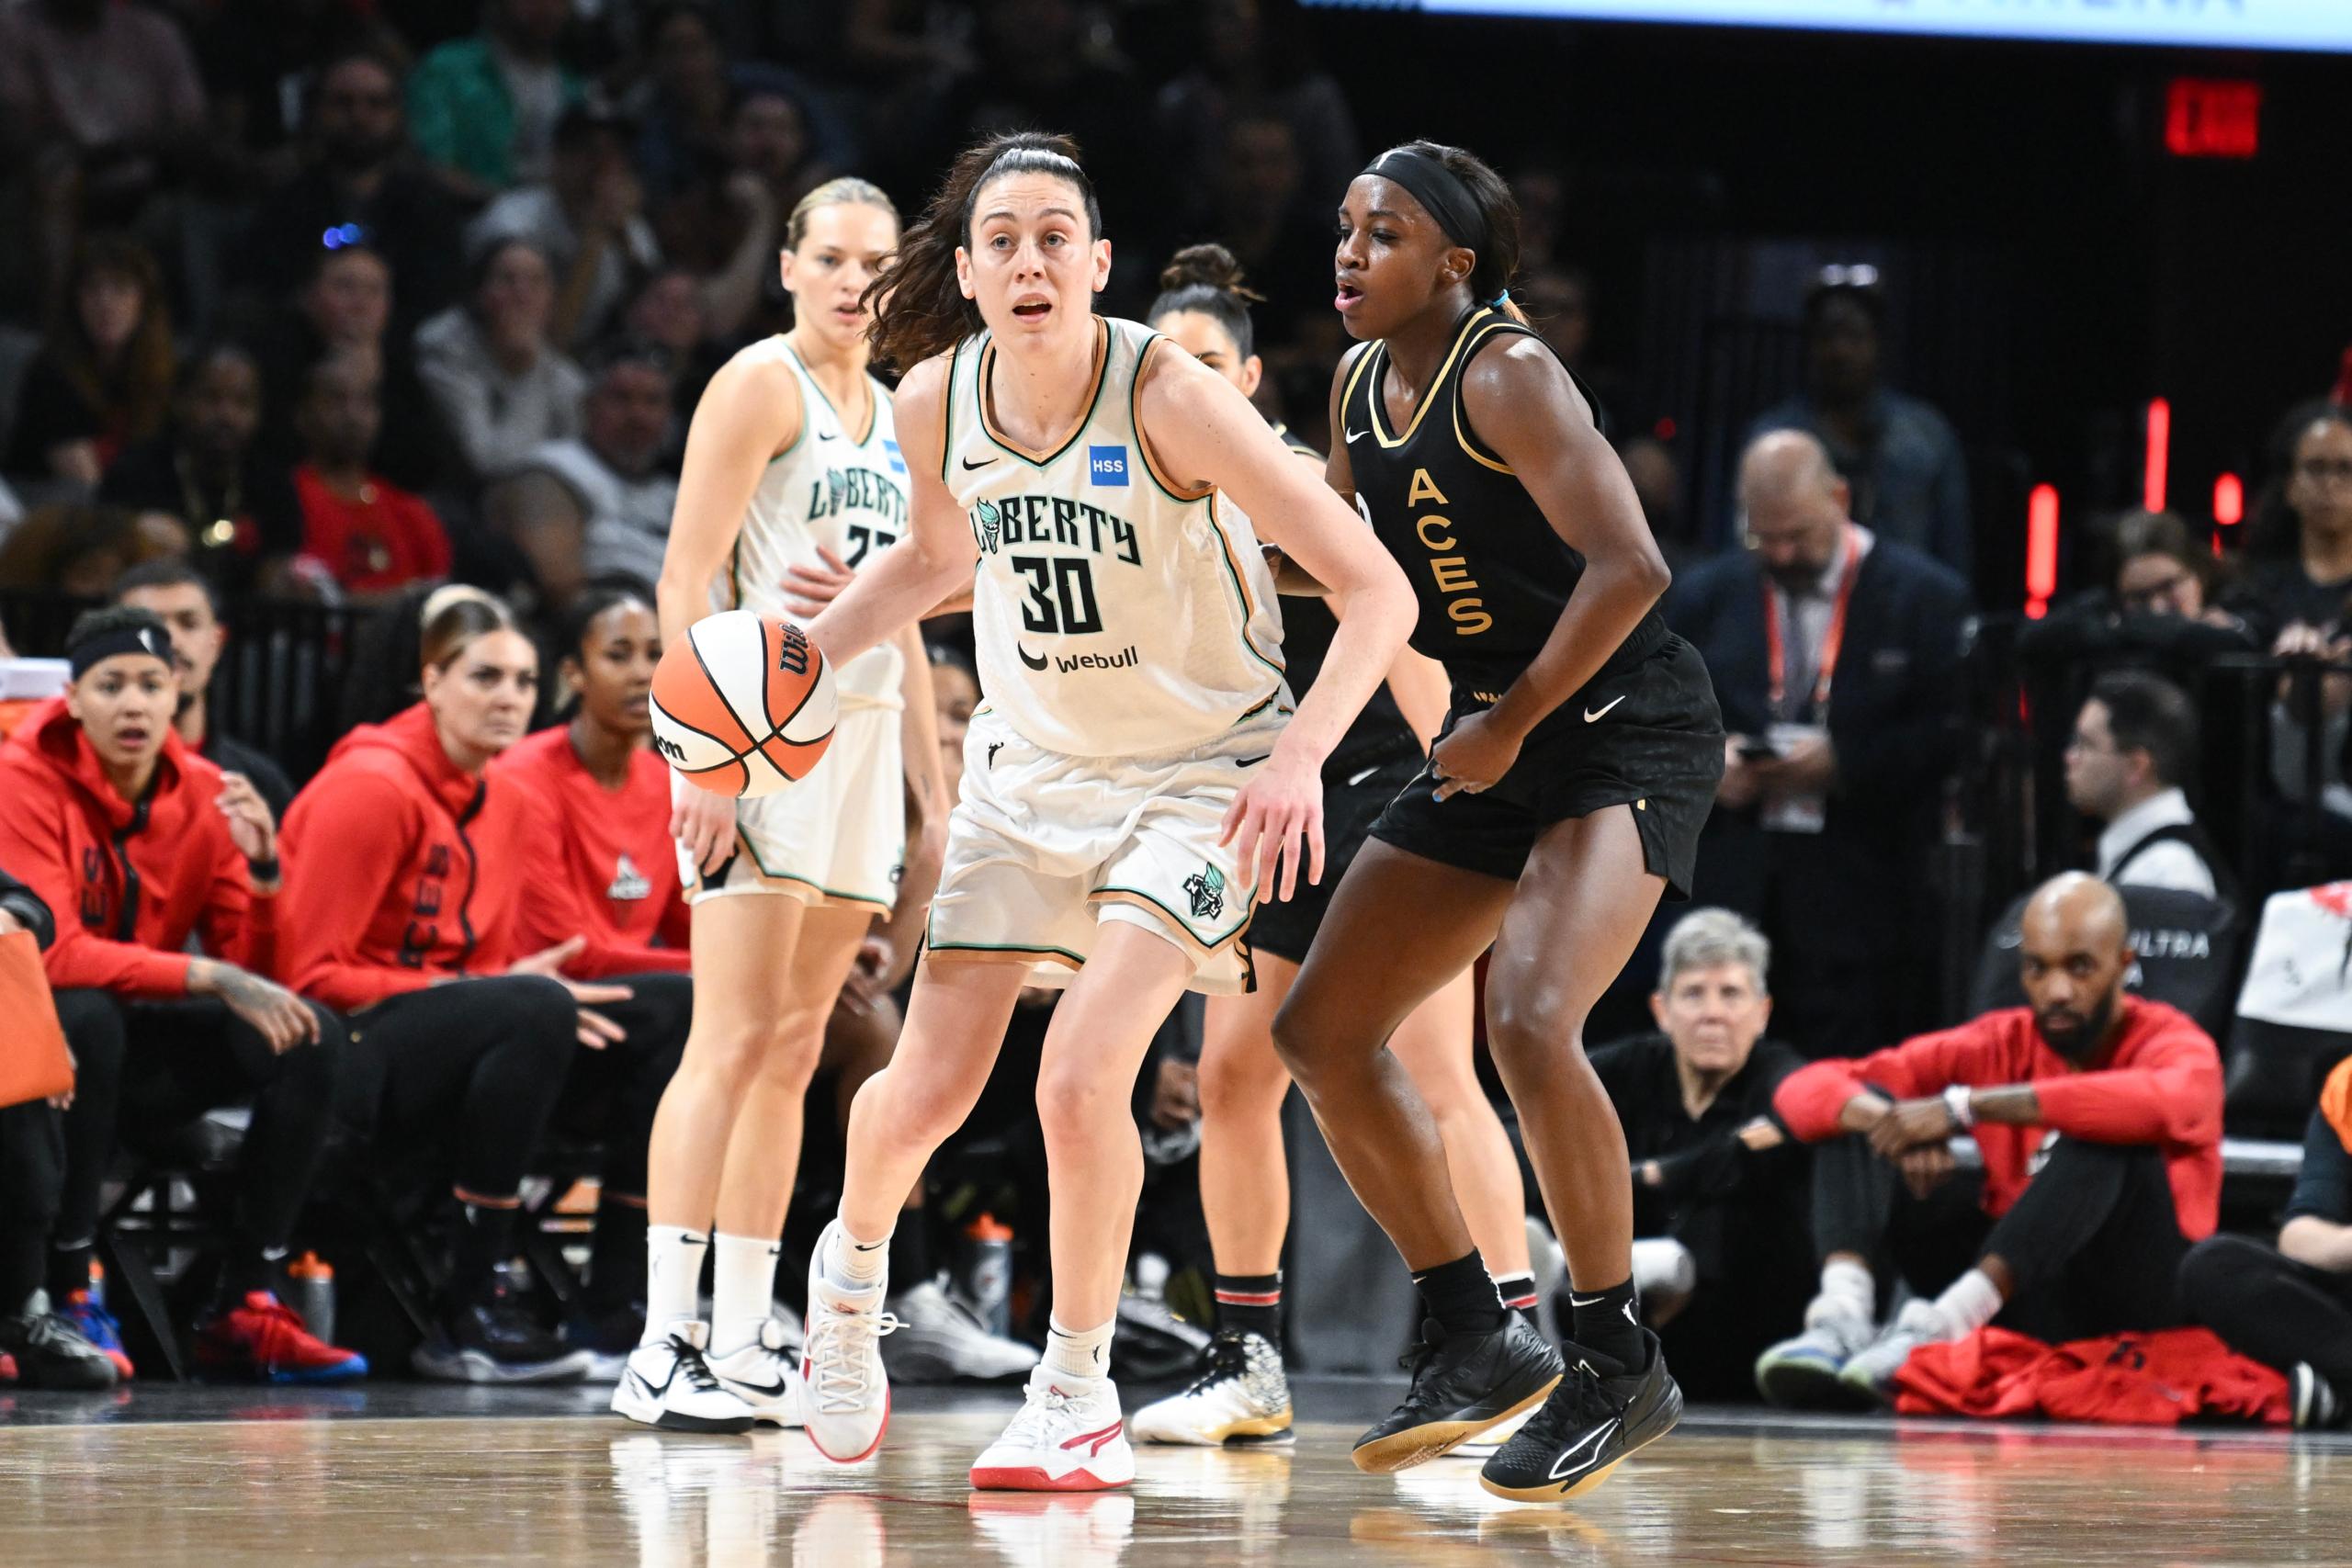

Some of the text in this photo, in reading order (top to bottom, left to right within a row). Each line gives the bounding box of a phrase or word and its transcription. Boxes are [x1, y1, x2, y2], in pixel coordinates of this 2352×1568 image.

[1092, 459, 1124, 473] HSS
[1408, 468, 1493, 636] ACES
[1011, 556, 1104, 635] 30
[779, 622, 809, 676] Wil
[1056, 646, 1139, 673] Webull
